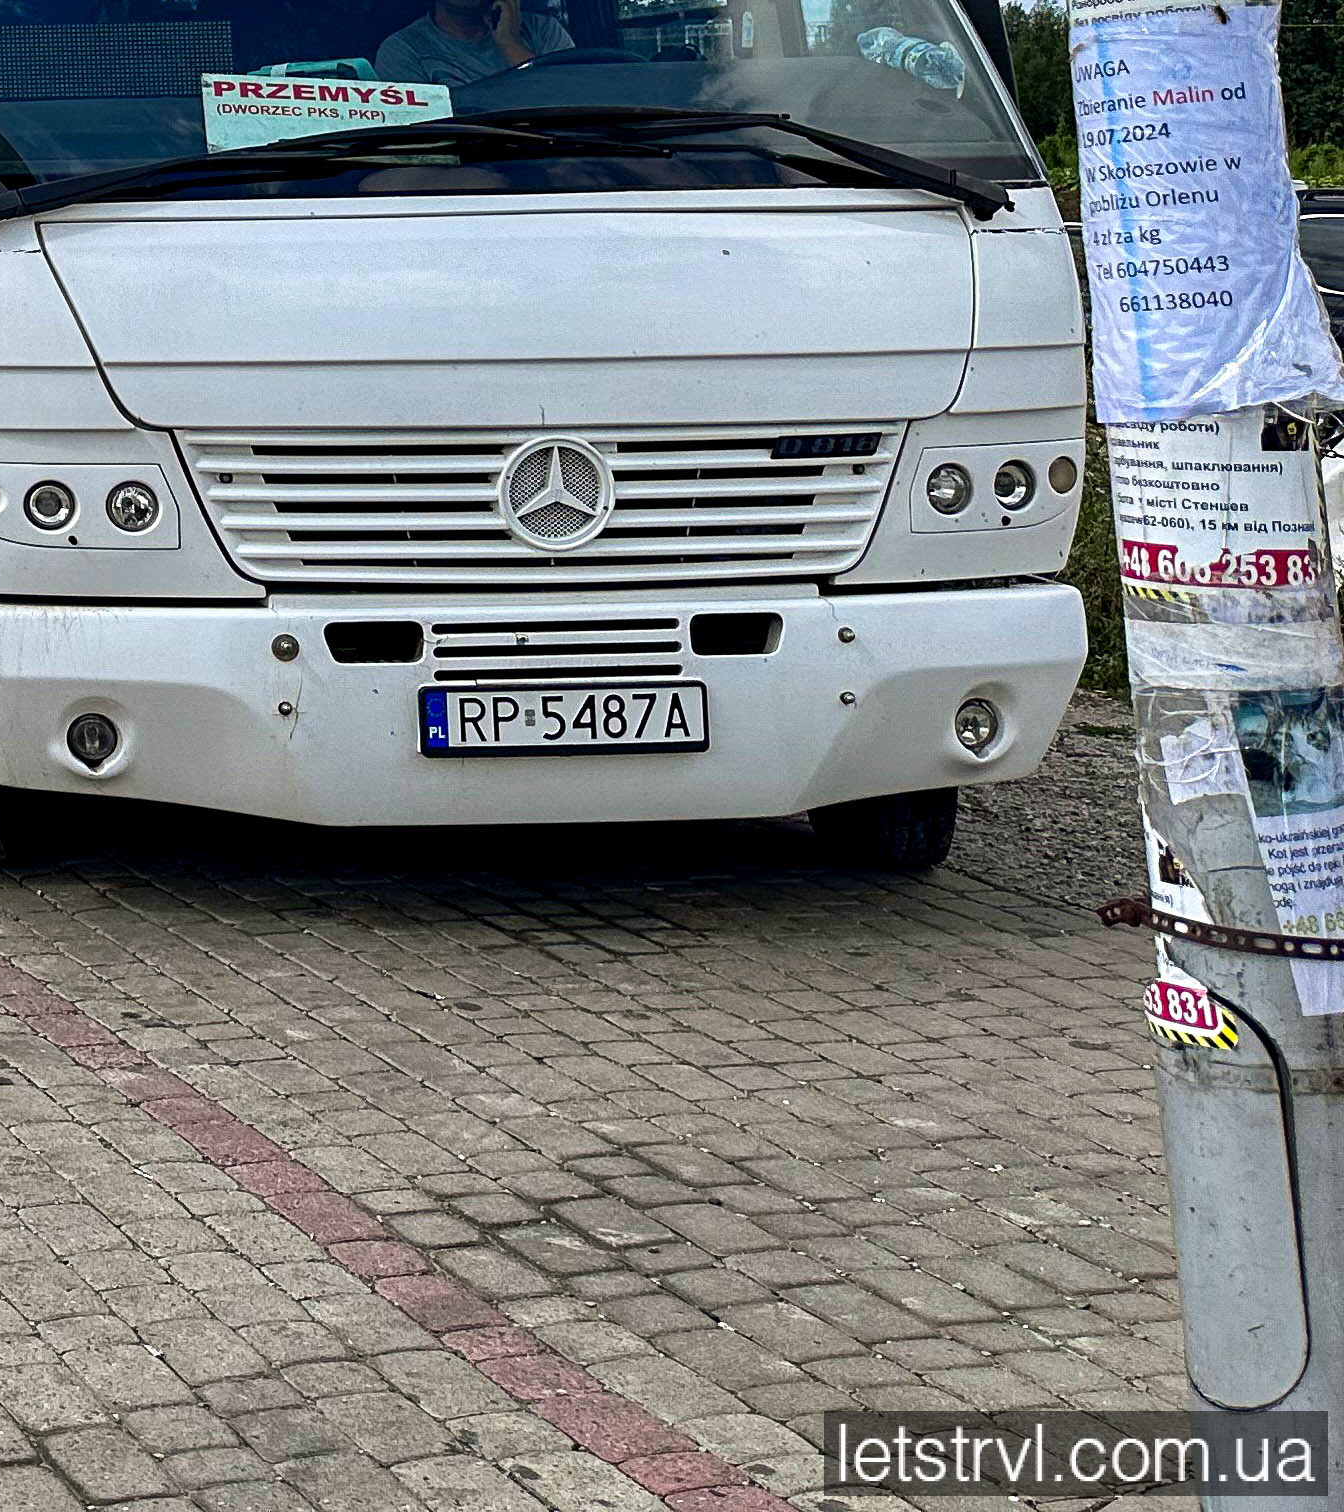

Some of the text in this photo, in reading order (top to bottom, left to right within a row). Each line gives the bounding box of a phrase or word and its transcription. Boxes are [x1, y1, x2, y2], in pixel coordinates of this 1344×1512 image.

[1075, 59, 1131, 84] UWAGA
[212, 80, 429, 107] PRZEMYŚL
[1078, 82, 1246, 117] Zbieranie Malin od
[216, 102, 386, 124] (DWORZEC PKS, PKP)
[1099, 156, 1218, 182] Skołoszowie
[1224, 155, 1242, 170] w
[1145, 188, 1220, 207] Orlenu
[1115, 231, 1133, 245] za
[1139, 226, 1162, 246] kg
[1116, 255, 1230, 279] 604750443
[1119, 290, 1234, 313] 661138040
[1160, 421, 1220, 436] роботи)
[1172, 460, 1285, 476] шпаклювання)
[1132, 475, 1220, 491] безкоштовно
[1200, 518, 1217, 531] 15
[1243, 521, 1269, 534] від
[458, 692, 691, 743] RP 5487A
[428, 725, 446, 739] PL
[1166, 987, 1215, 1028] 831
